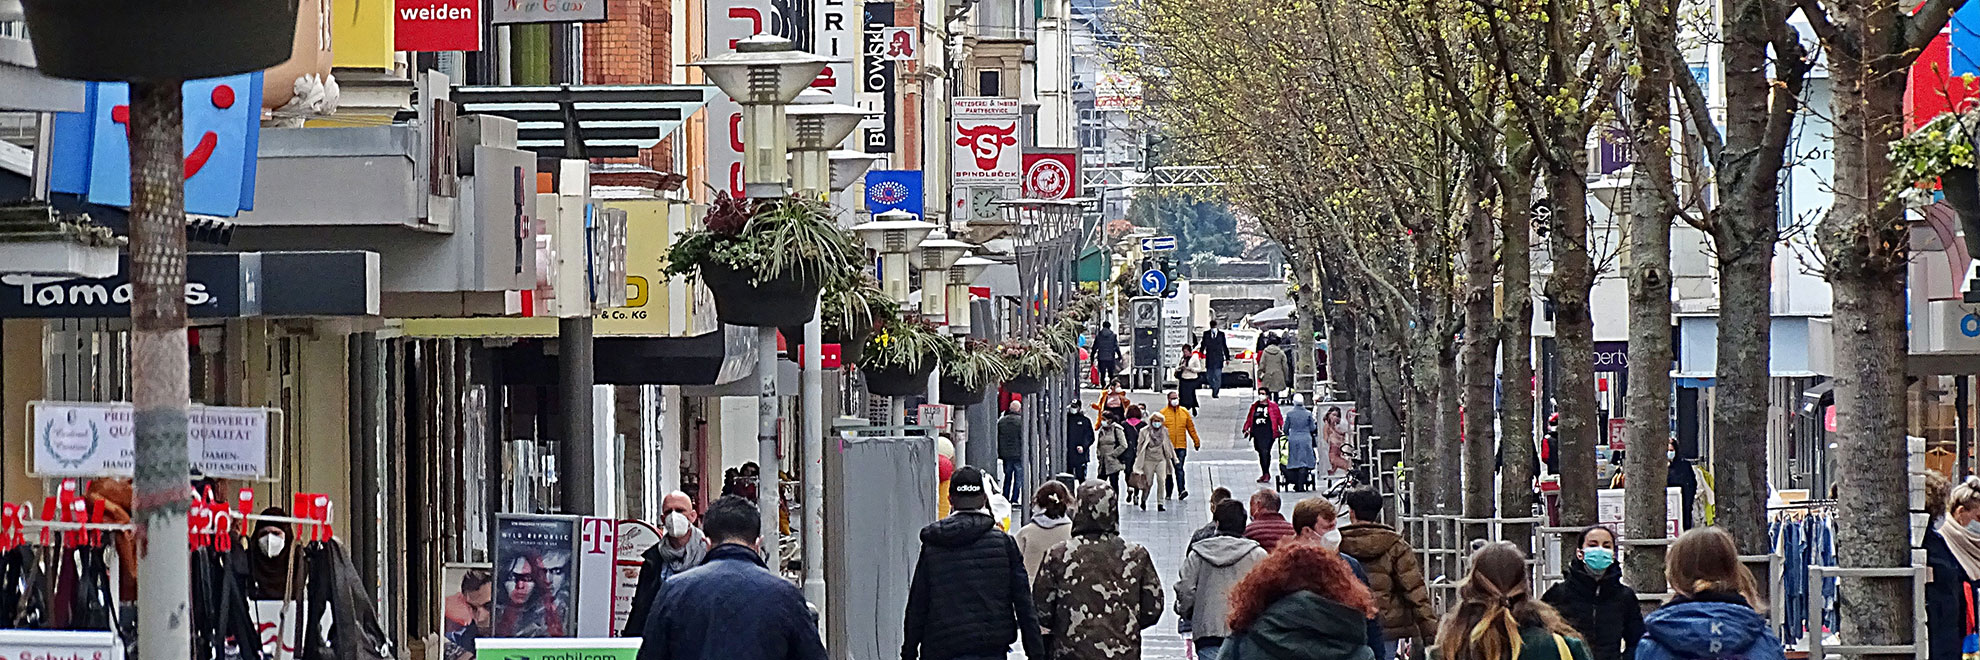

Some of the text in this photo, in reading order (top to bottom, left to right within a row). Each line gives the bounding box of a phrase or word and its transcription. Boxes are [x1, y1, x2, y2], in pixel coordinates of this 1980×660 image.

[400, 3, 471, 20] weiden
[976, 134, 999, 159] S
[1, 274, 209, 306] Tamas
[601, 311, 647, 319] & Co. KG
